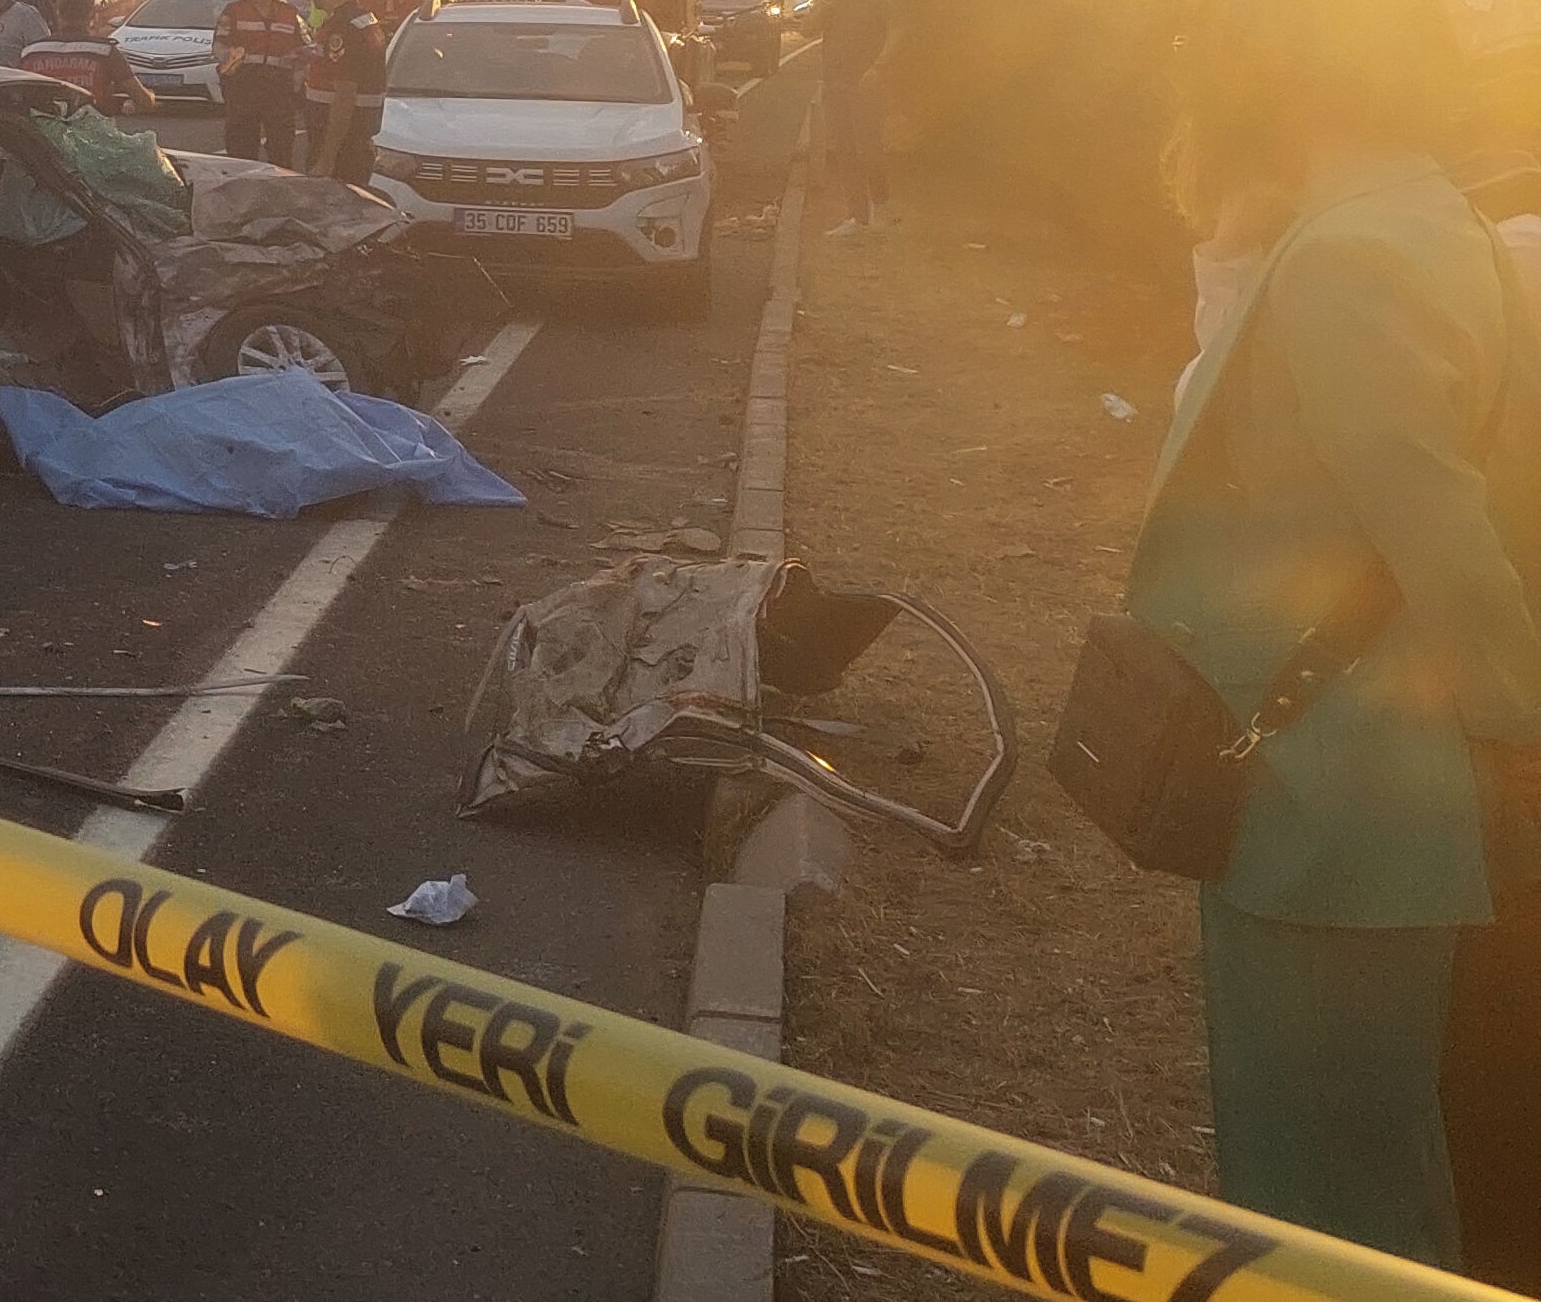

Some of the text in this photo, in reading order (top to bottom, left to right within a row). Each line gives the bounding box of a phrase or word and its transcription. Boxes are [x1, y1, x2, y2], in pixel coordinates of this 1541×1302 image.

[465, 212, 486, 230] 35
[537, 216, 569, 234] 659
[77, 876, 306, 1019] OLAY
[372, 960, 594, 1127] YERİ
